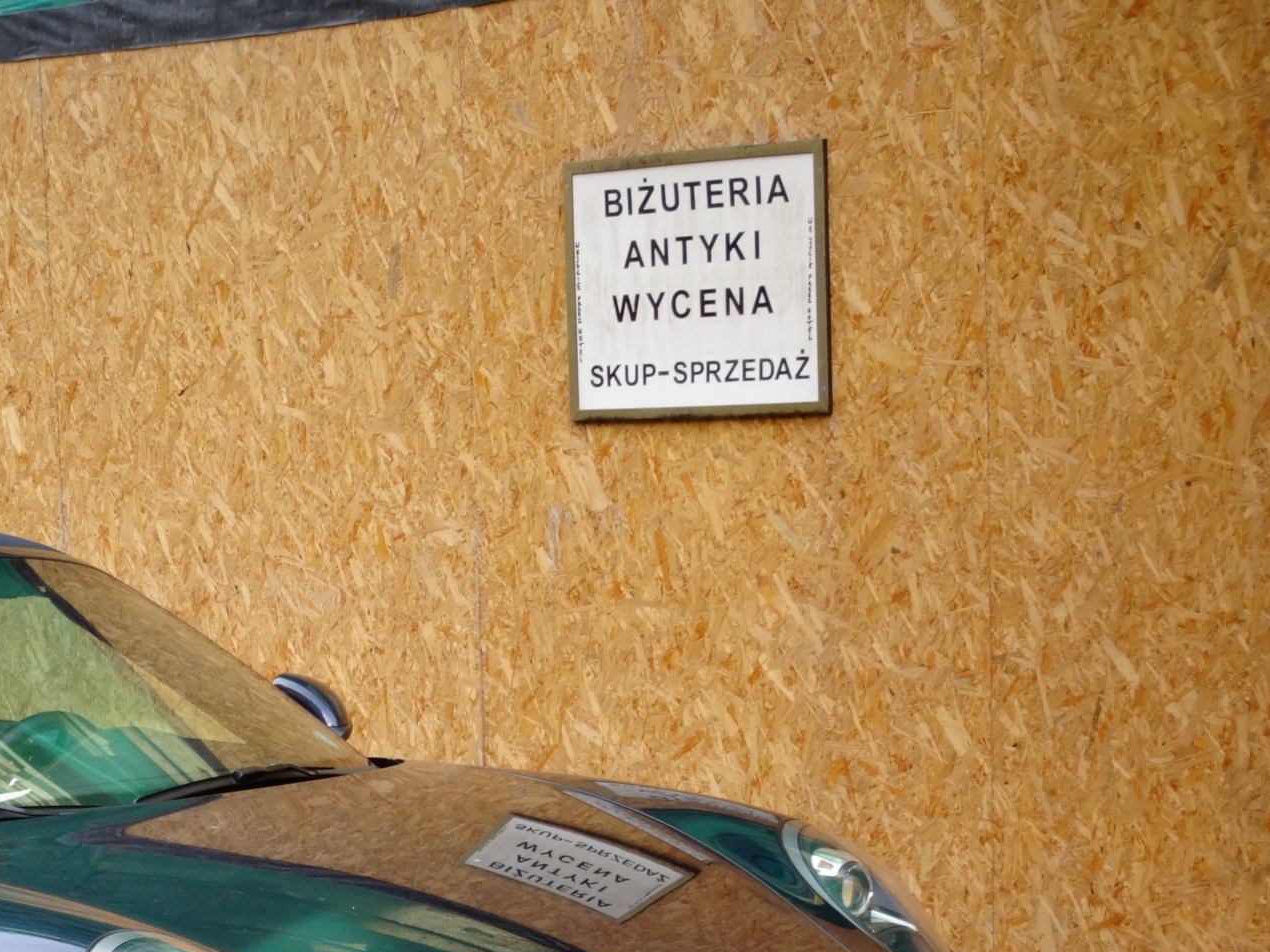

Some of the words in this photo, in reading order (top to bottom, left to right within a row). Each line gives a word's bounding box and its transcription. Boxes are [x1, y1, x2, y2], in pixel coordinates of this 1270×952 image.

[604, 174, 790, 218] BIŻUTERIA
[623, 230, 760, 269] ANTYKI
[612, 285, 774, 323] WYCENA
[590, 349, 811, 388] SKUP-SPRZEDAŻ
